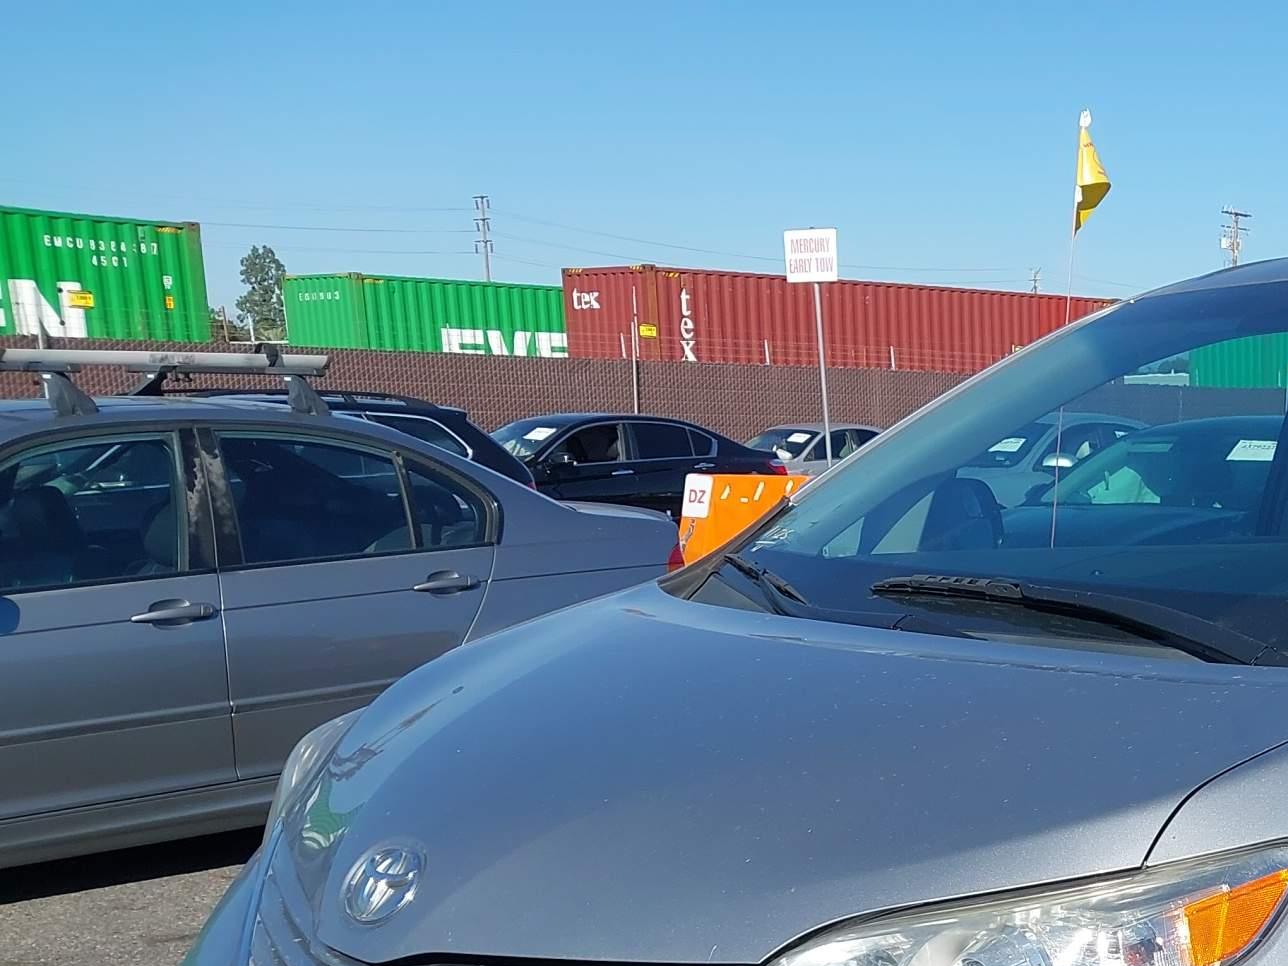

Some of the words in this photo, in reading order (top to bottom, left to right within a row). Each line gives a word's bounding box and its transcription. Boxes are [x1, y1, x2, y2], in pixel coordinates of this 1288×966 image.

[790, 237, 830, 254] MERCURY
[789, 257, 812, 273] EARLY
[815, 256, 834, 272] TOW
[0, 279, 88, 337] N
[572, 288, 600, 310] tex
[680, 287, 698, 361] tex
[688, 489, 706, 504] DZ
